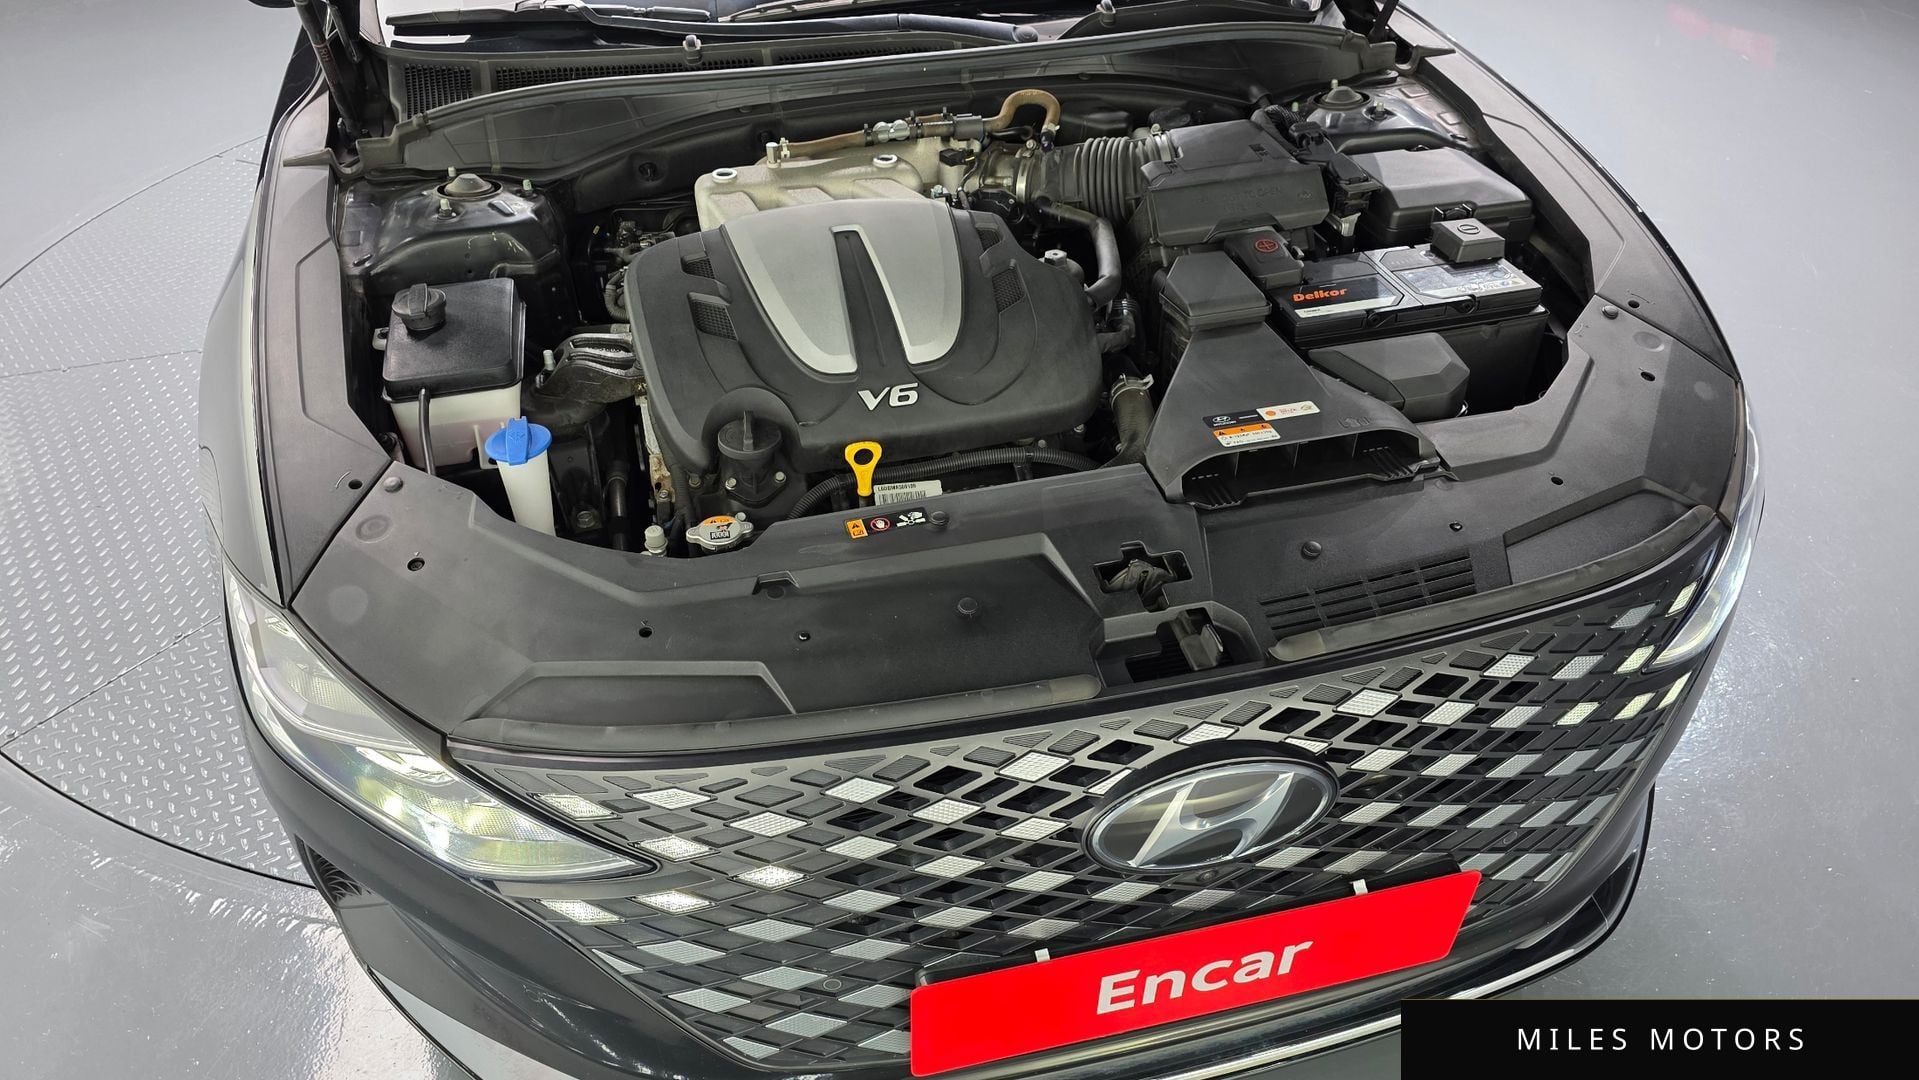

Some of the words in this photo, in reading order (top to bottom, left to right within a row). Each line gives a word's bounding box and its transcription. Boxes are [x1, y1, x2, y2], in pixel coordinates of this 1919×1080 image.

[1293, 288, 1347, 302] Delkor
[858, 382, 919, 411] V6
[1096, 941, 1314, 1015] Encar
